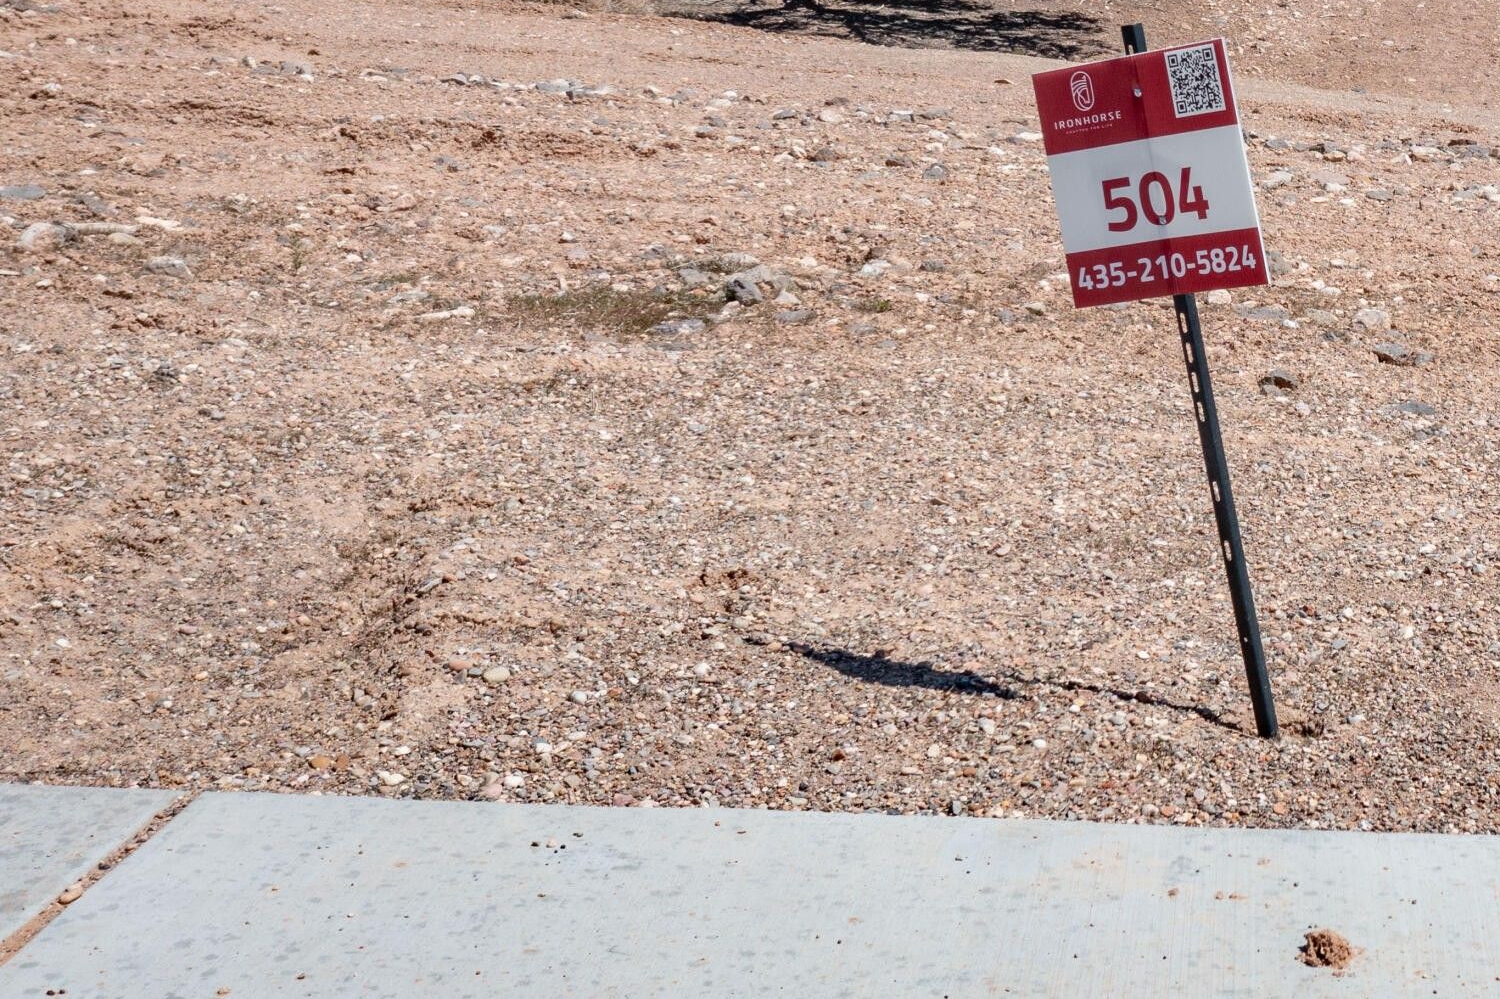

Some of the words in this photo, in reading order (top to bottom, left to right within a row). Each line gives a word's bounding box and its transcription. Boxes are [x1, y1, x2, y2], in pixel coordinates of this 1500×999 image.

[1054, 110, 1122, 130] IRONHORSE
[1102, 167, 1210, 232] 504
[1078, 245, 1256, 290] 435-210-5824
